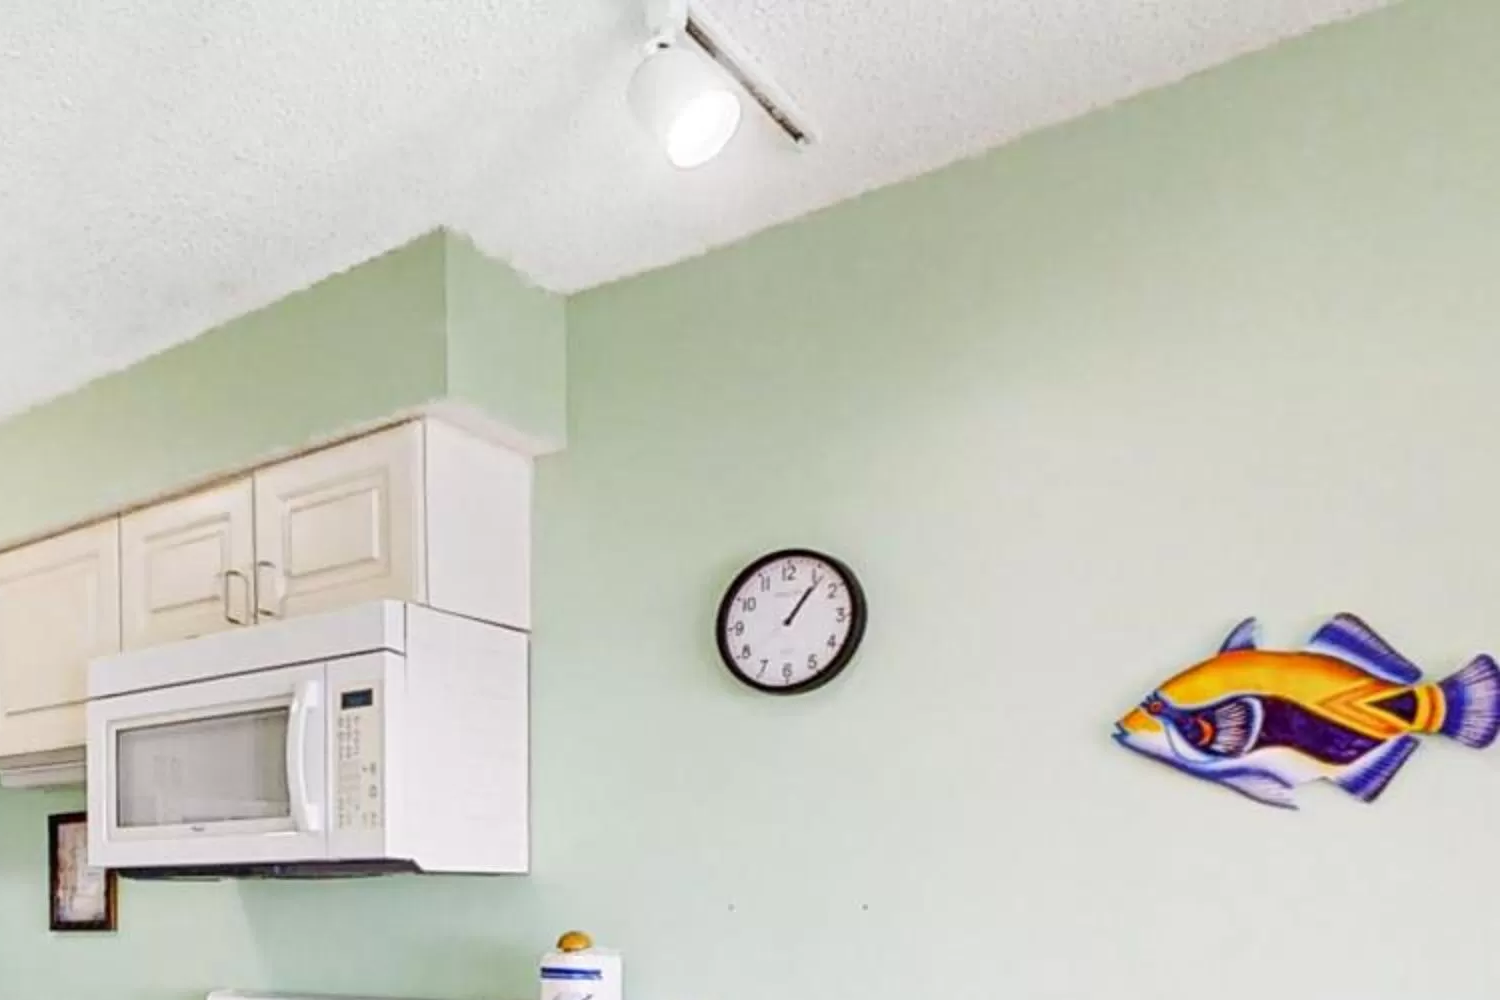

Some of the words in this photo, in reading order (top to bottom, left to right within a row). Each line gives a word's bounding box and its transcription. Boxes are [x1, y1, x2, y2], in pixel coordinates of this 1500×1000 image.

[781, 565, 797, 582] 12
[761, 576, 771, 592] 11
[828, 583, 837, 598] 2
[742, 597, 756, 612] 10
[835, 606, 845, 623] 3
[735, 621, 745, 636] 9
[826, 634, 837, 648] 4
[741, 644, 752, 659] 8
[759, 659, 769, 674] 7
[807, 653, 818, 669] 5
[782, 662, 793, 678] 6
